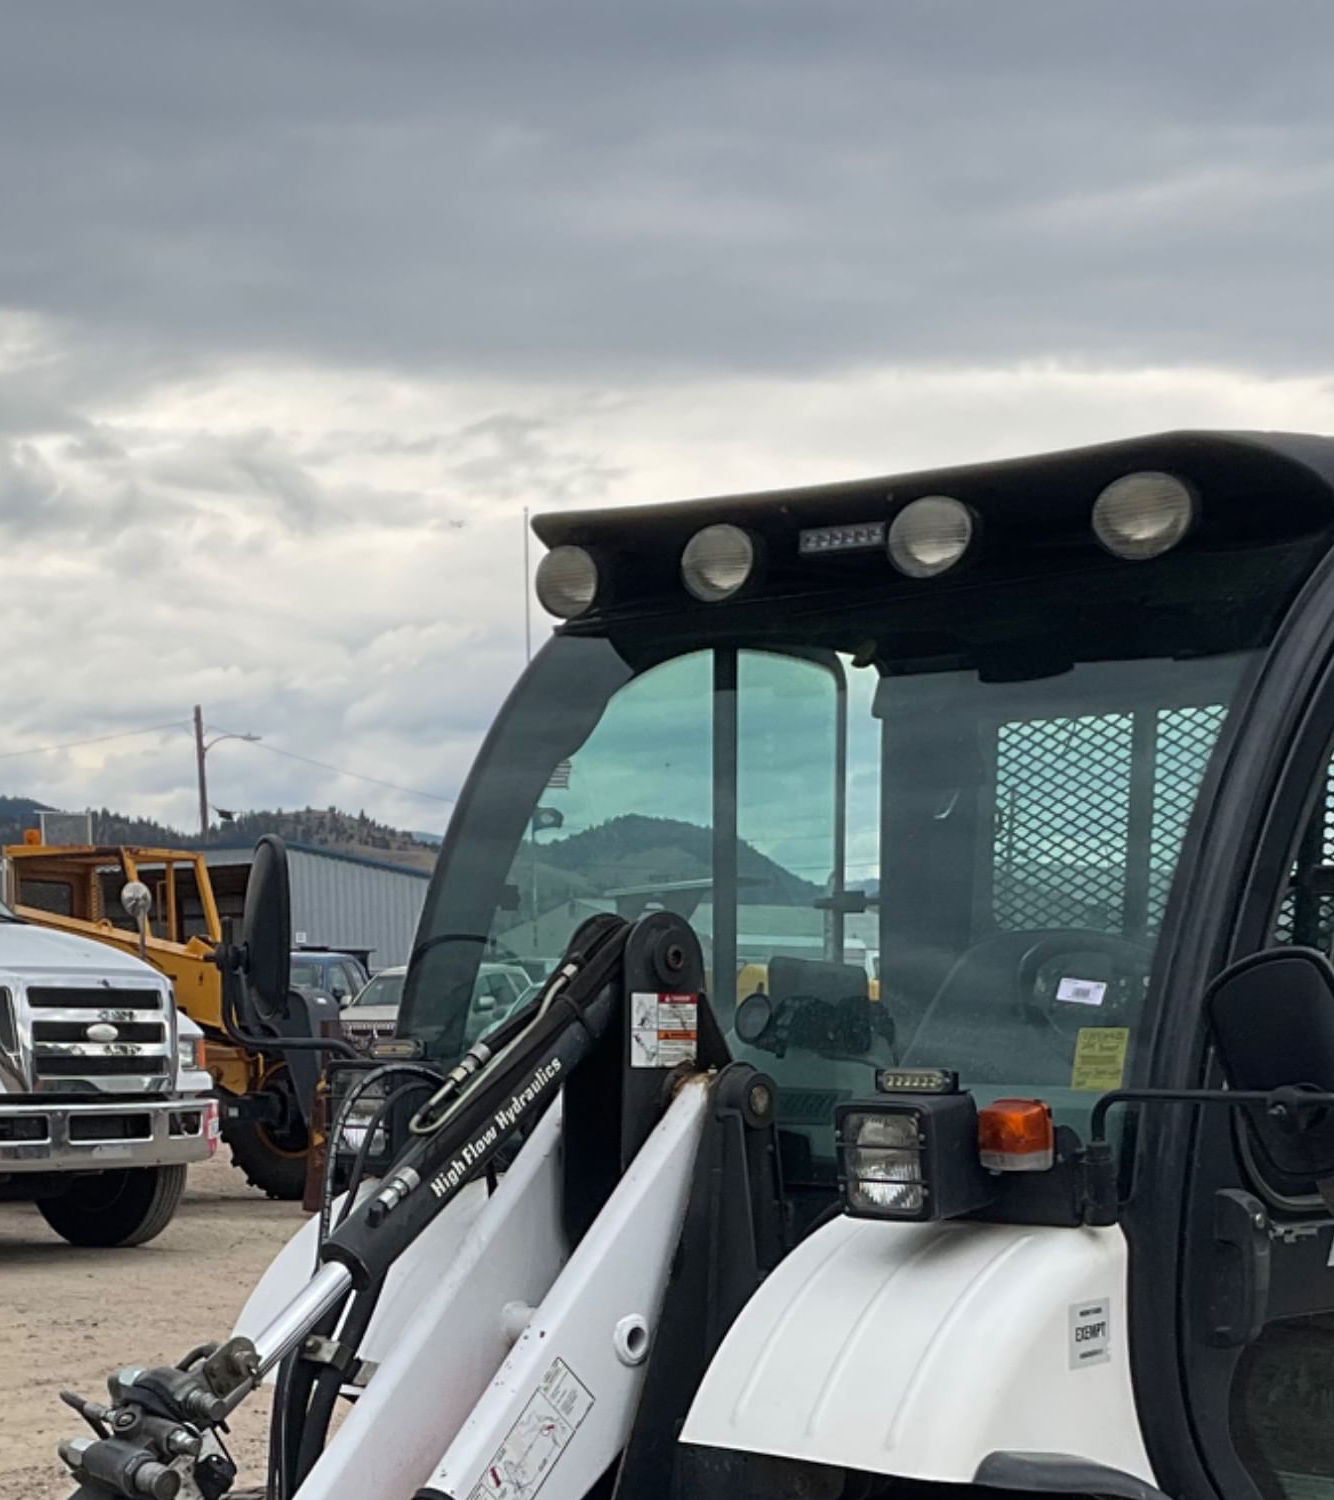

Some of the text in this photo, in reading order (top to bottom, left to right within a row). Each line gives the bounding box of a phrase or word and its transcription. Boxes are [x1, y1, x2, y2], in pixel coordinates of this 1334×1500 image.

[430, 1057, 563, 1198] High Flow Hydraulics
[1074, 1320, 1107, 1342] EXEMPT
